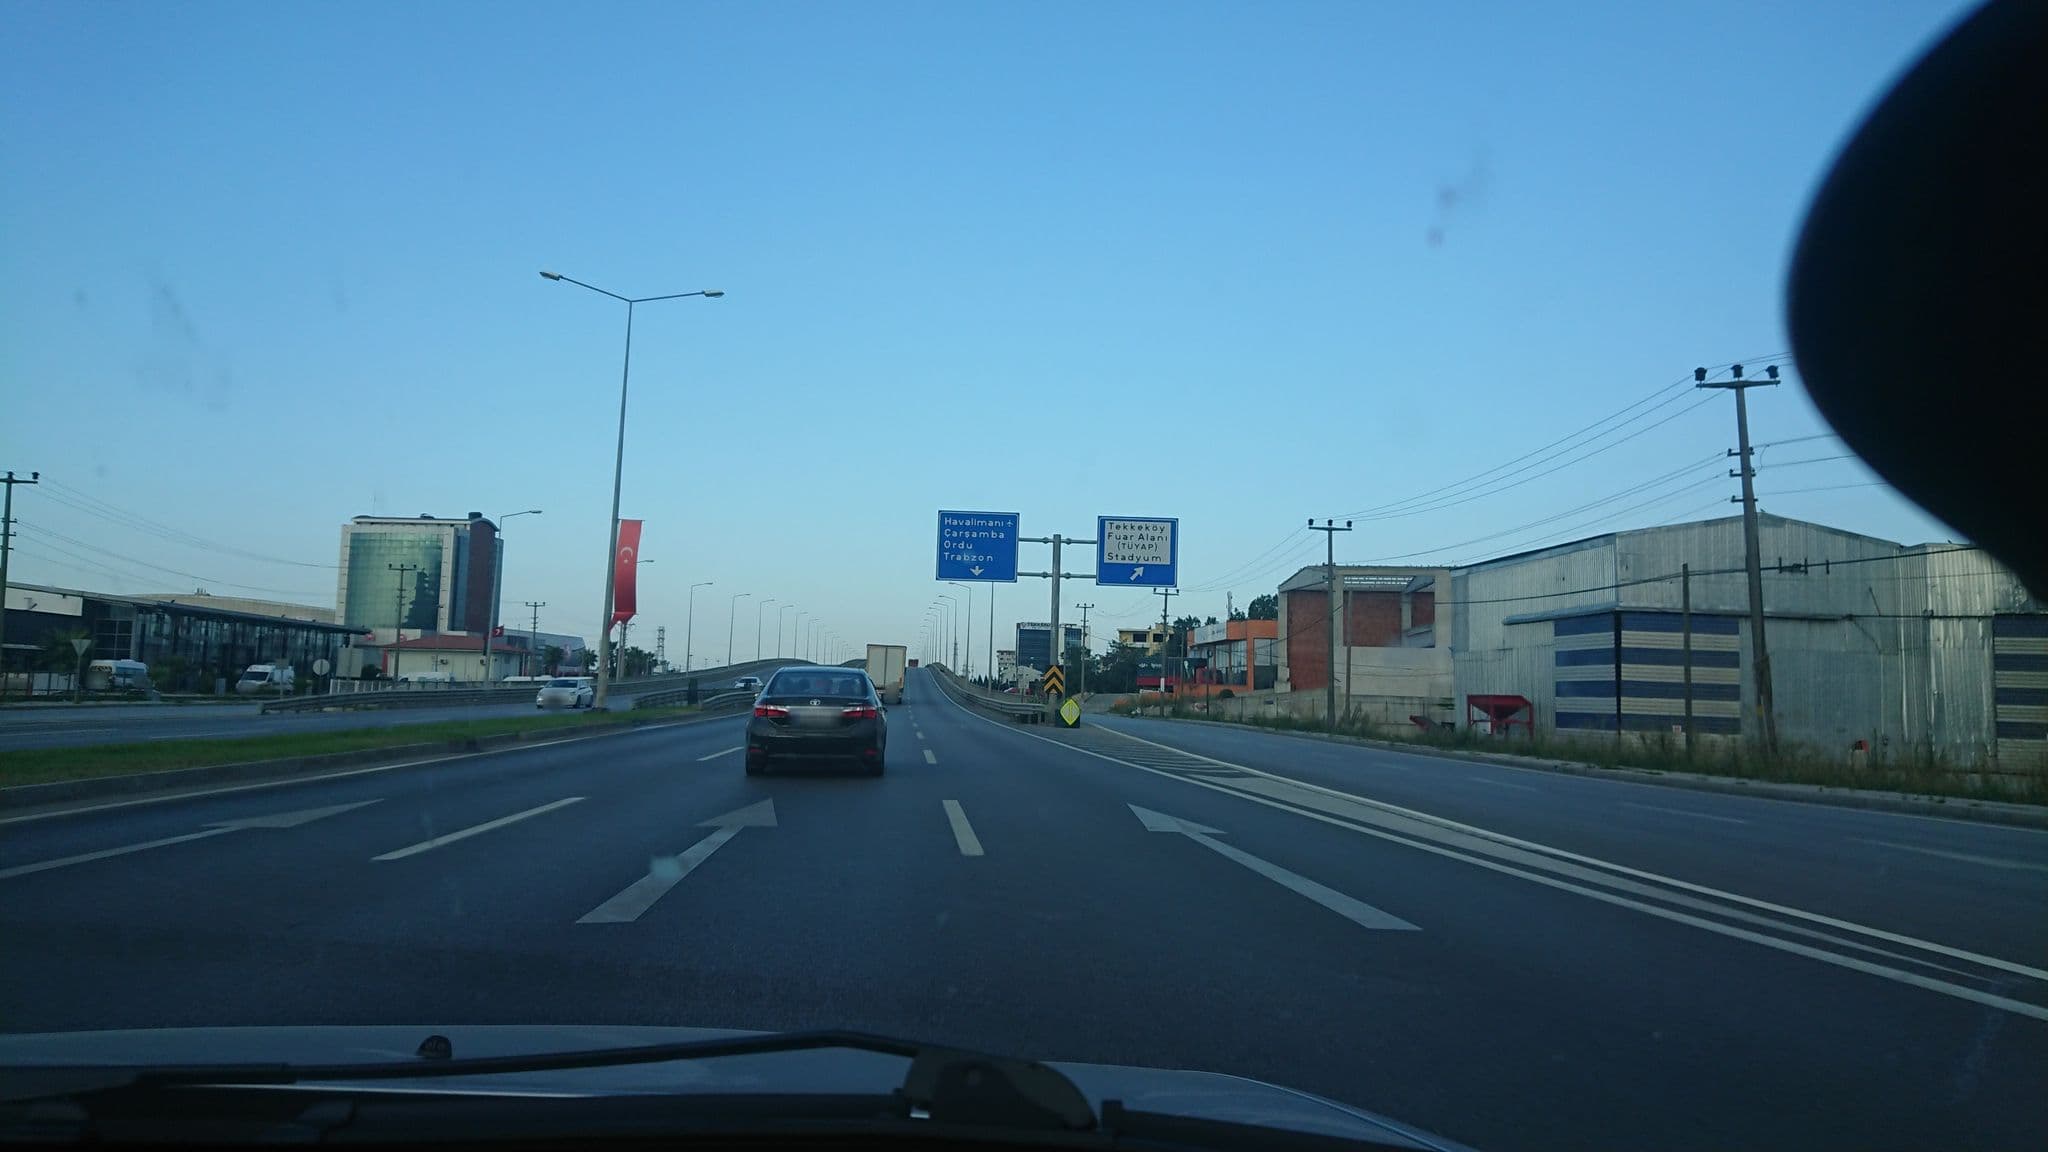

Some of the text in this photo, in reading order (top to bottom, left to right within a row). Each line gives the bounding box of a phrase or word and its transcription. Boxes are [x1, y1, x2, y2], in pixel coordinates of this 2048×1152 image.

[944, 528, 1004, 539] Çarşamba
[1107, 532, 1168, 542] Fuar Alanı
[943, 540, 973, 549] Ordu
[943, 552, 993, 562] Trabzon
[1107, 552, 1161, 563] Stadyum
